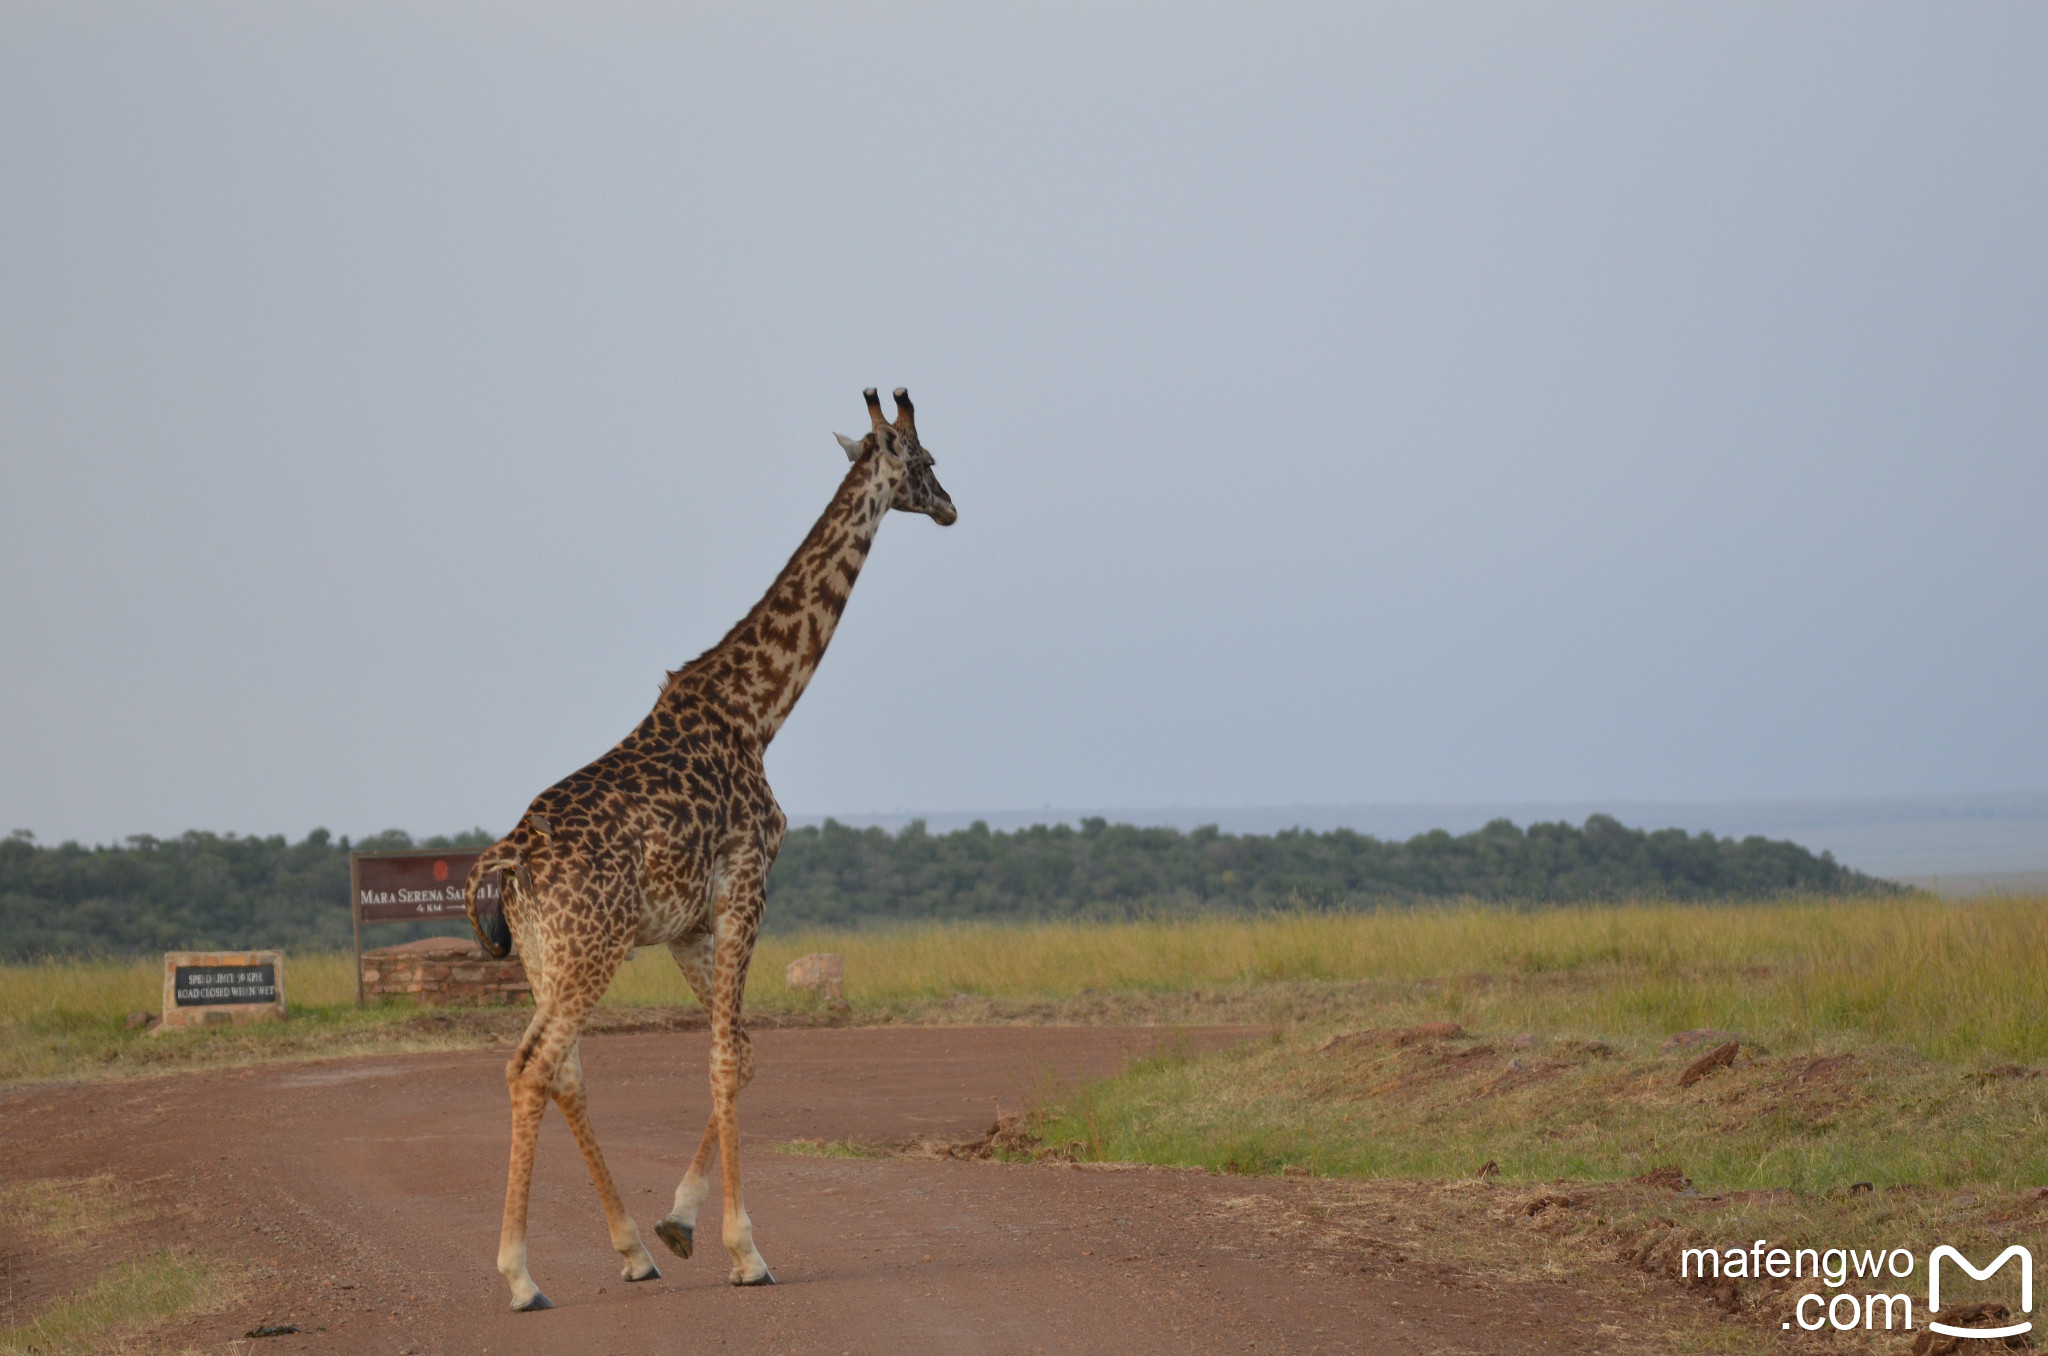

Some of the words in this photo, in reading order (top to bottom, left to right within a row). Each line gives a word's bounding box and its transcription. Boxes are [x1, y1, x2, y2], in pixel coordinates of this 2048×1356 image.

[360, 889, 396, 904] MARA
[398, 888, 443, 902] SERENA
[446, 885, 485, 900] SAFI
[416, 904, 424, 912] 4
[426, 904, 442, 912] KM
[177, 988, 199, 999] ROAD
[200, 987, 230, 998] CLOSED
[257, 985, 275, 996] WET
